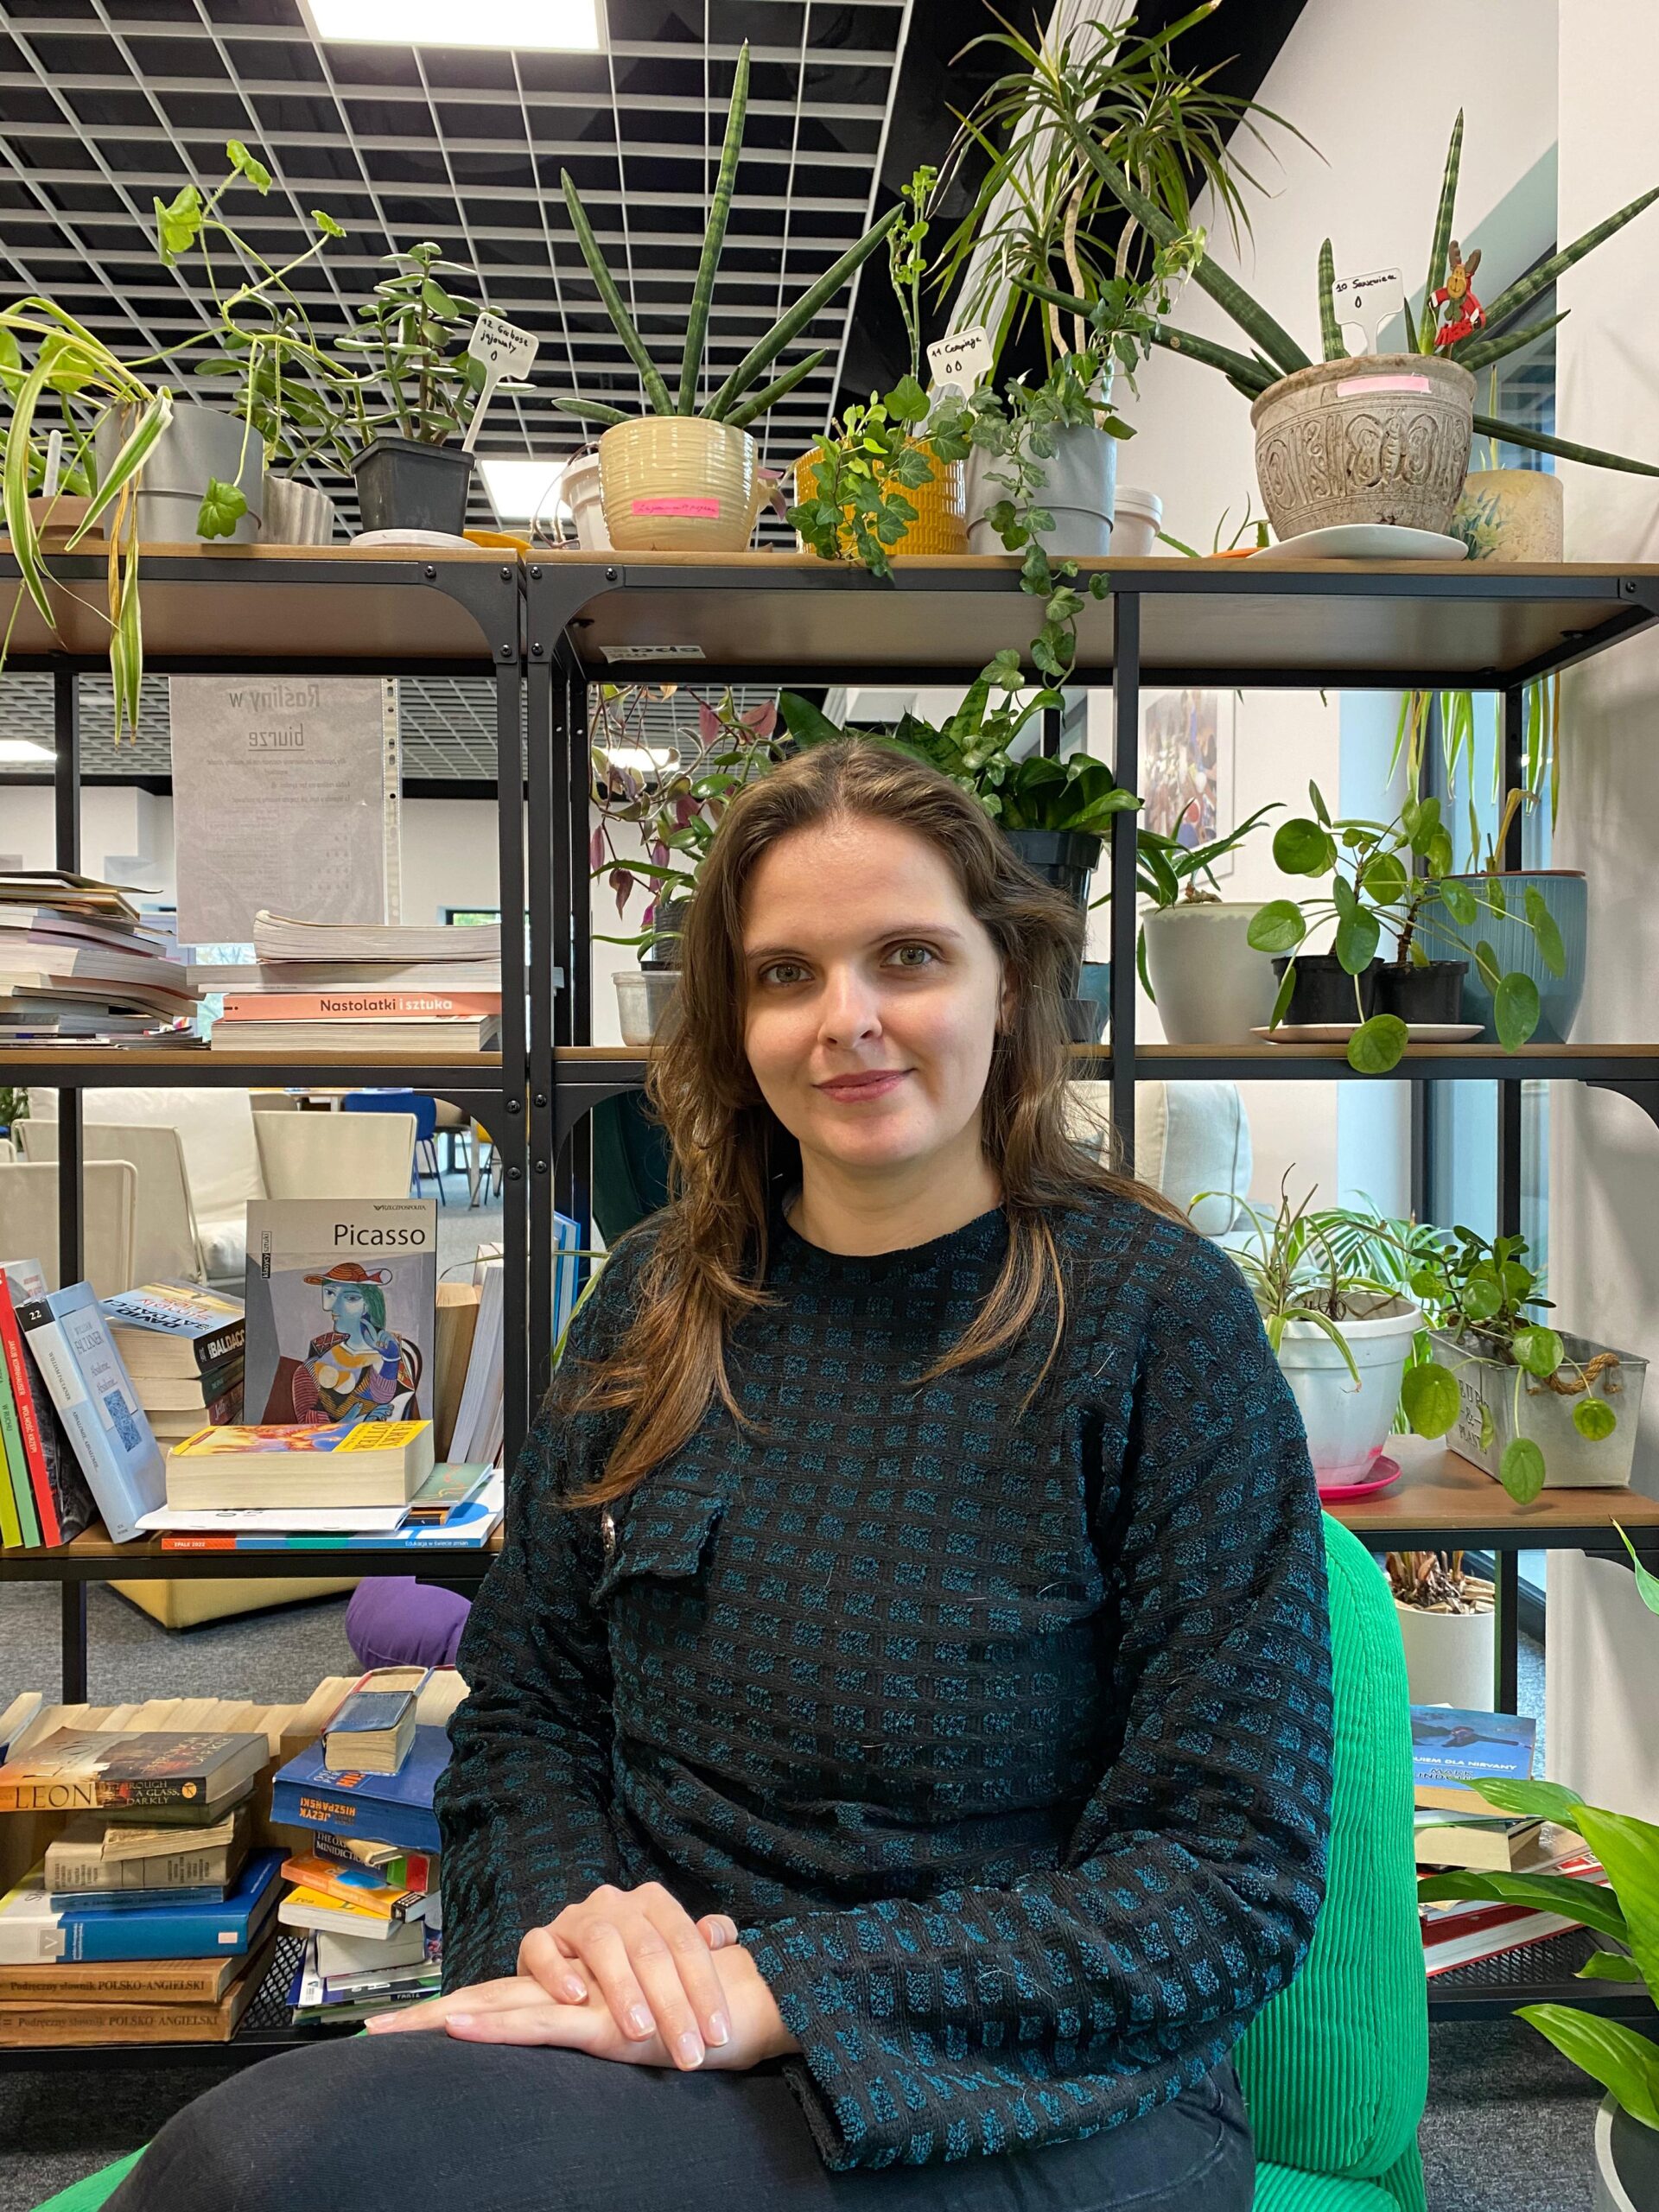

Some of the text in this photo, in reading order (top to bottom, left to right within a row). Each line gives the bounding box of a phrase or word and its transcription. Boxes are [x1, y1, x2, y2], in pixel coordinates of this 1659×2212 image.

[1336, 283, 1348, 292] 10
[481, 318, 493, 329] 12
[321, 999, 453, 1012] Nastolatki i sztuka
[334, 1224, 425, 1246] Picasso
[29, 1309, 41, 1320] 22
[104, 1300, 213, 1330] BALDACCI
[116, 1309, 181, 1328] DAVID
[8, 1340, 26, 1396] JAKUB KORNHAUSER
[48, 1351, 72, 1402] WILLIAM FAULKNER
[353, 1424, 392, 1450] OTTER
[16, 1784, 92, 1808] LEON
[127, 1796, 169, 1806] DARKLY
[300, 1797, 356, 1817] HISZPAŃSKI
[317, 1831, 332, 1843] THE
[10, 1981, 57, 1993] Podręczny
[98, 1980, 205, 1991] POLSKO-ANGIELSKI
[18, 2017, 66, 2028] Podręczny
